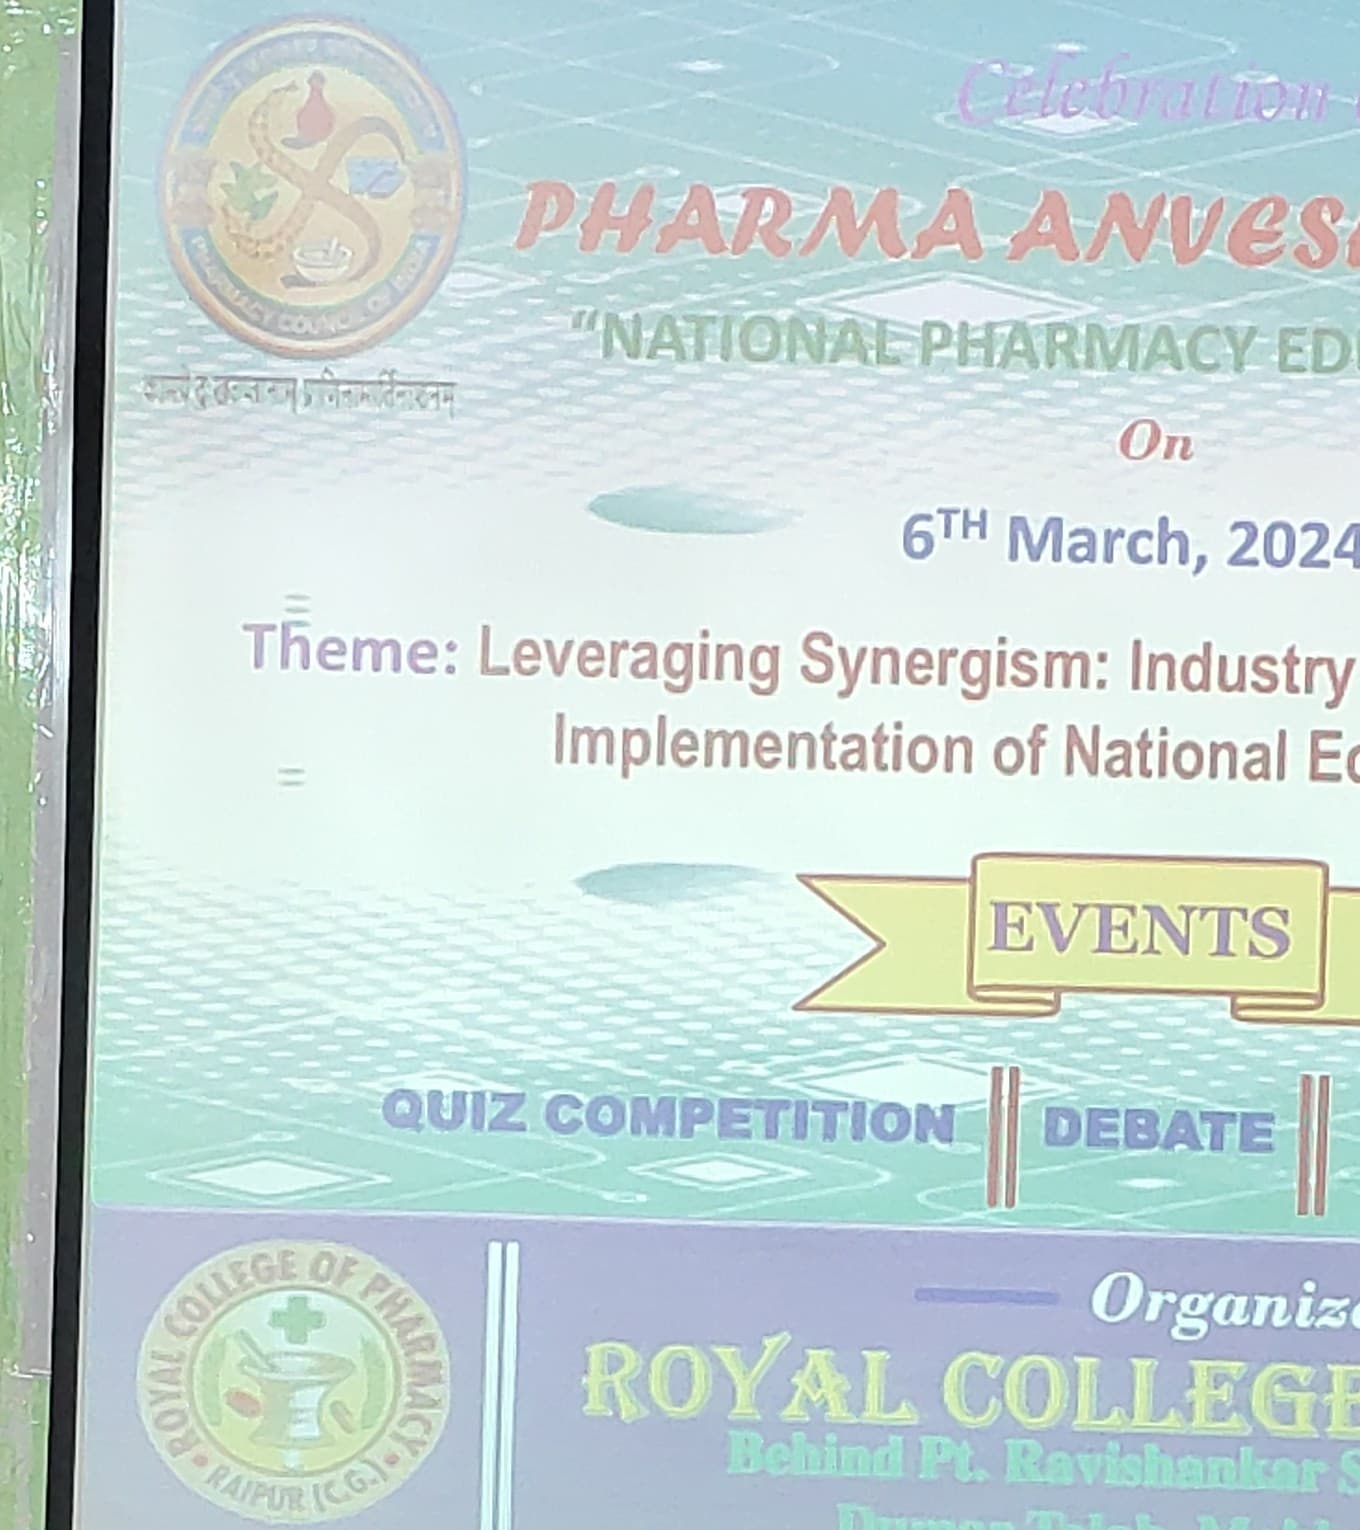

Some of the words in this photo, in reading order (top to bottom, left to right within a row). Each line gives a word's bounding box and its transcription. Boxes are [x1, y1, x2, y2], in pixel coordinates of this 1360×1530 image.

[957, 51, 1329, 125] Celebration
[514, 180, 983, 260] PHARMA
[572, 309, 901, 366] “NATIONAL
[919, 321, 1258, 374] PHARMACY
[1119, 418, 1194, 462] On
[1009, 515, 1208, 575] March,
[243, 621, 458, 676] Theme:
[480, 625, 780, 695] Leveraging
[801, 631, 1110, 701] Synergism:
[1130, 640, 1355, 709] Industry
[554, 712, 974, 779] Implementation
[993, 724, 1046, 777] of
[1065, 725, 1288, 781] National
[988, 901, 1290, 958] EVENTS
[382, 1089, 527, 1133] QUIZ
[545, 1093, 956, 1144] COMPETITION
[1044, 1106, 1275, 1153] DEBATE
[163, 1250, 298, 1338] COLLEGE
[309, 1251, 359, 1284] OF
[360, 1272, 444, 1457] PHARMACY
[582, 1331, 920, 1426] ROYAL
[148, 1350, 202, 1458] ROYAL
[206, 1464, 306, 1512] RAIPUR
[313, 1459, 387, 1513] (C.G.)
[729, 1431, 903, 1479] Behind
[920, 1435, 987, 1483] Pt.
[1005, 1439, 1326, 1495] Ravishankar
